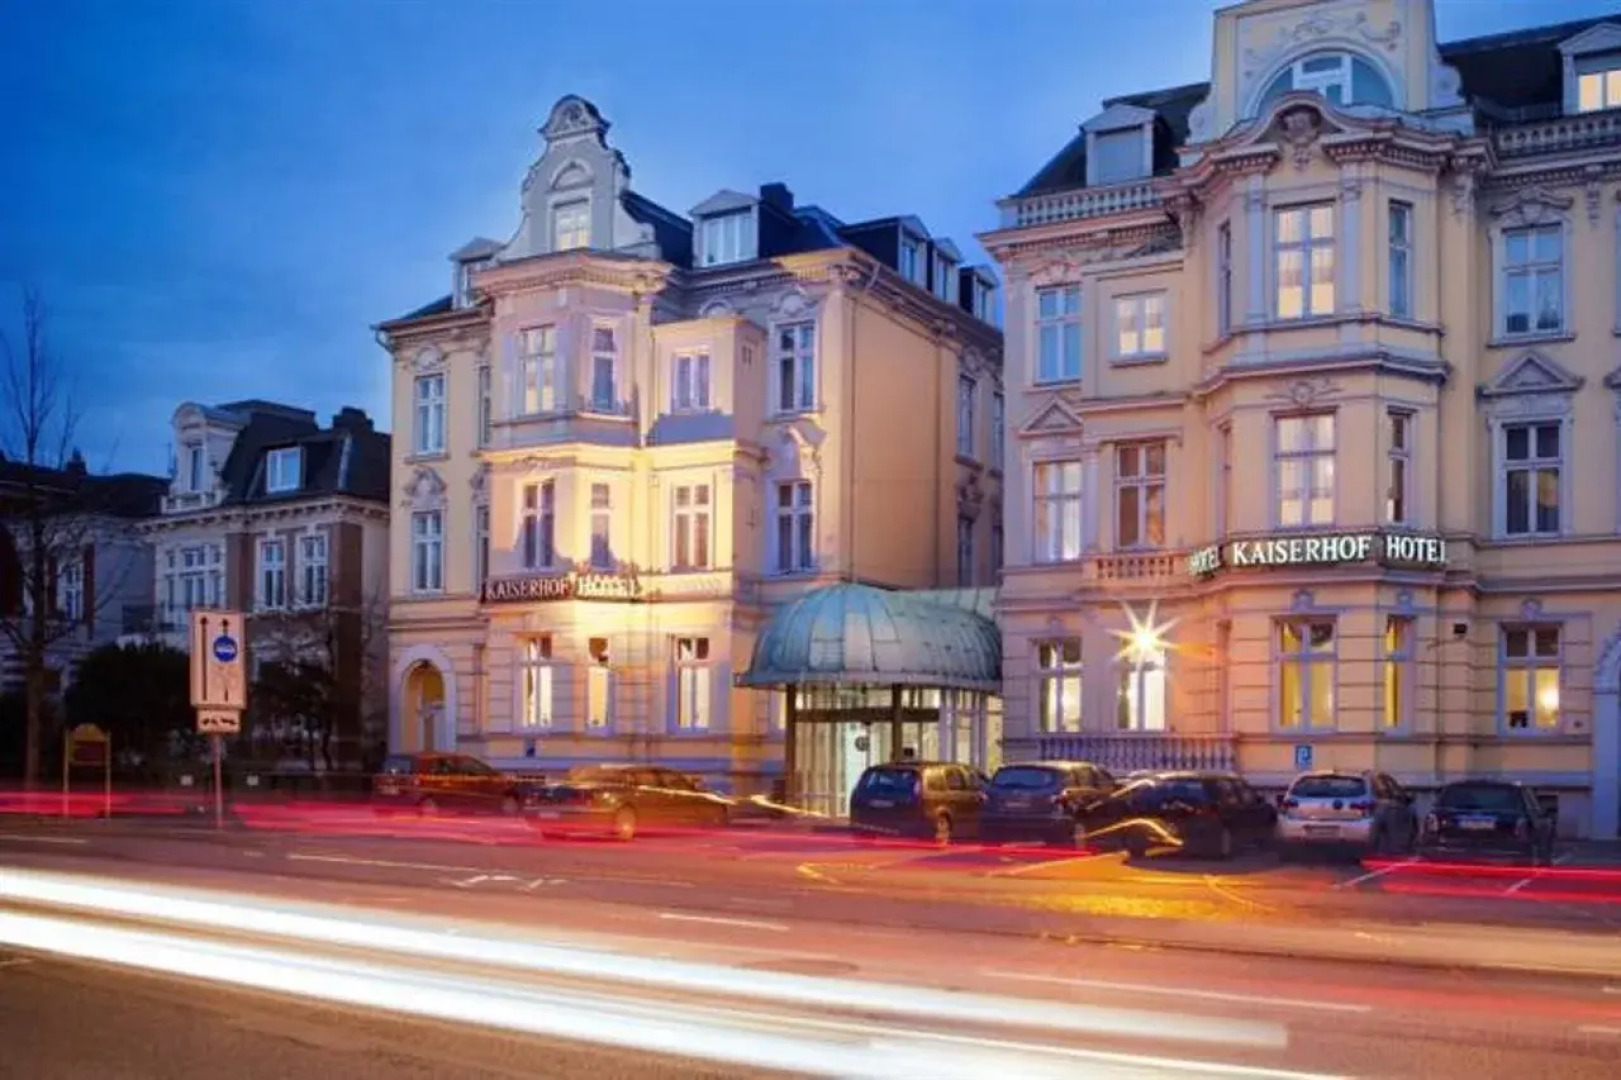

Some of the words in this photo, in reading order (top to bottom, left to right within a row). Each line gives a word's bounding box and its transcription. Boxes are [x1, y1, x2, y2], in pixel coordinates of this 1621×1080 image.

[1232, 535, 1372, 565] KAISERHOF
[1387, 536, 1446, 563] HOTEL
[486, 578, 568, 600] KAISERHOF
[579, 575, 635, 597] HOTEL
